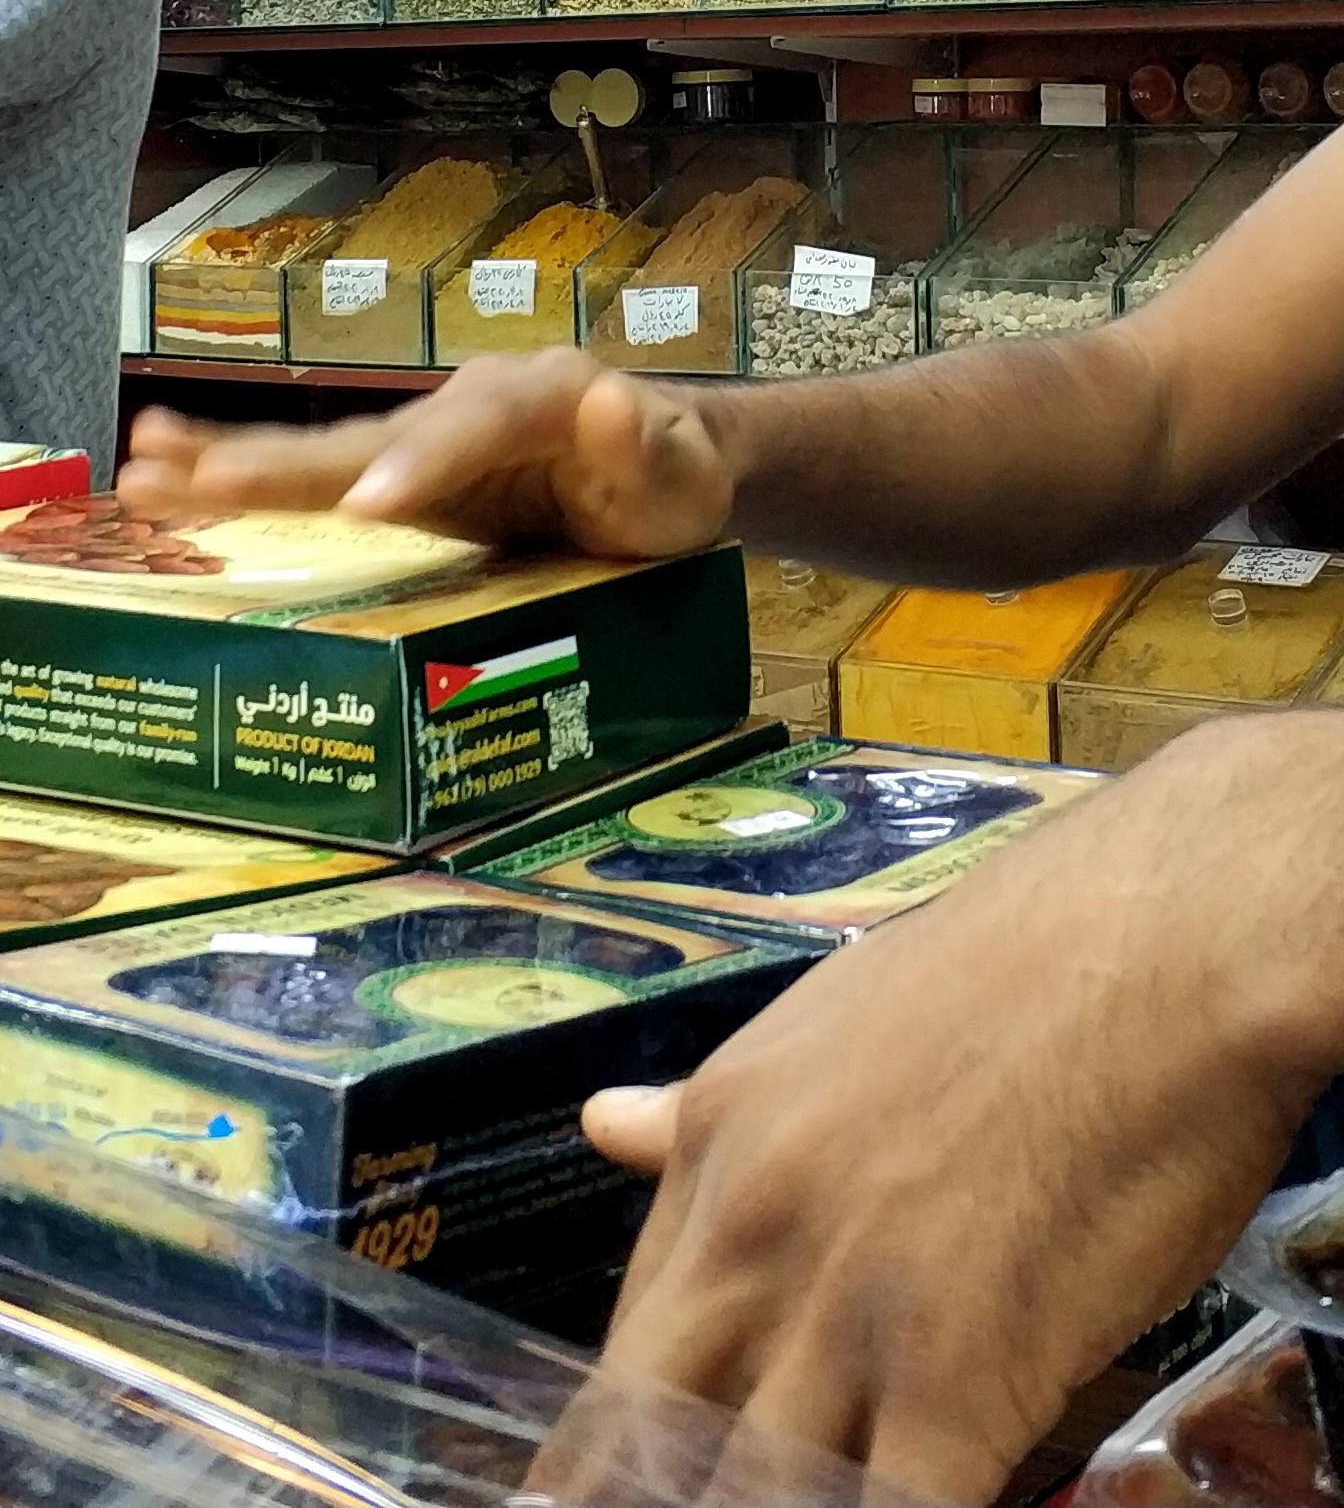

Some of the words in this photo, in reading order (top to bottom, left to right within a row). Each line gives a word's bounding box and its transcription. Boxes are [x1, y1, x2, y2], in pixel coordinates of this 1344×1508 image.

[236, 681, 309, 725] أردني
[311, 692, 376, 728] منتج
[235, 726, 298, 751] PRODUCT
[301, 736, 320, 754] OF
[321, 739, 375, 763] JORDAN
